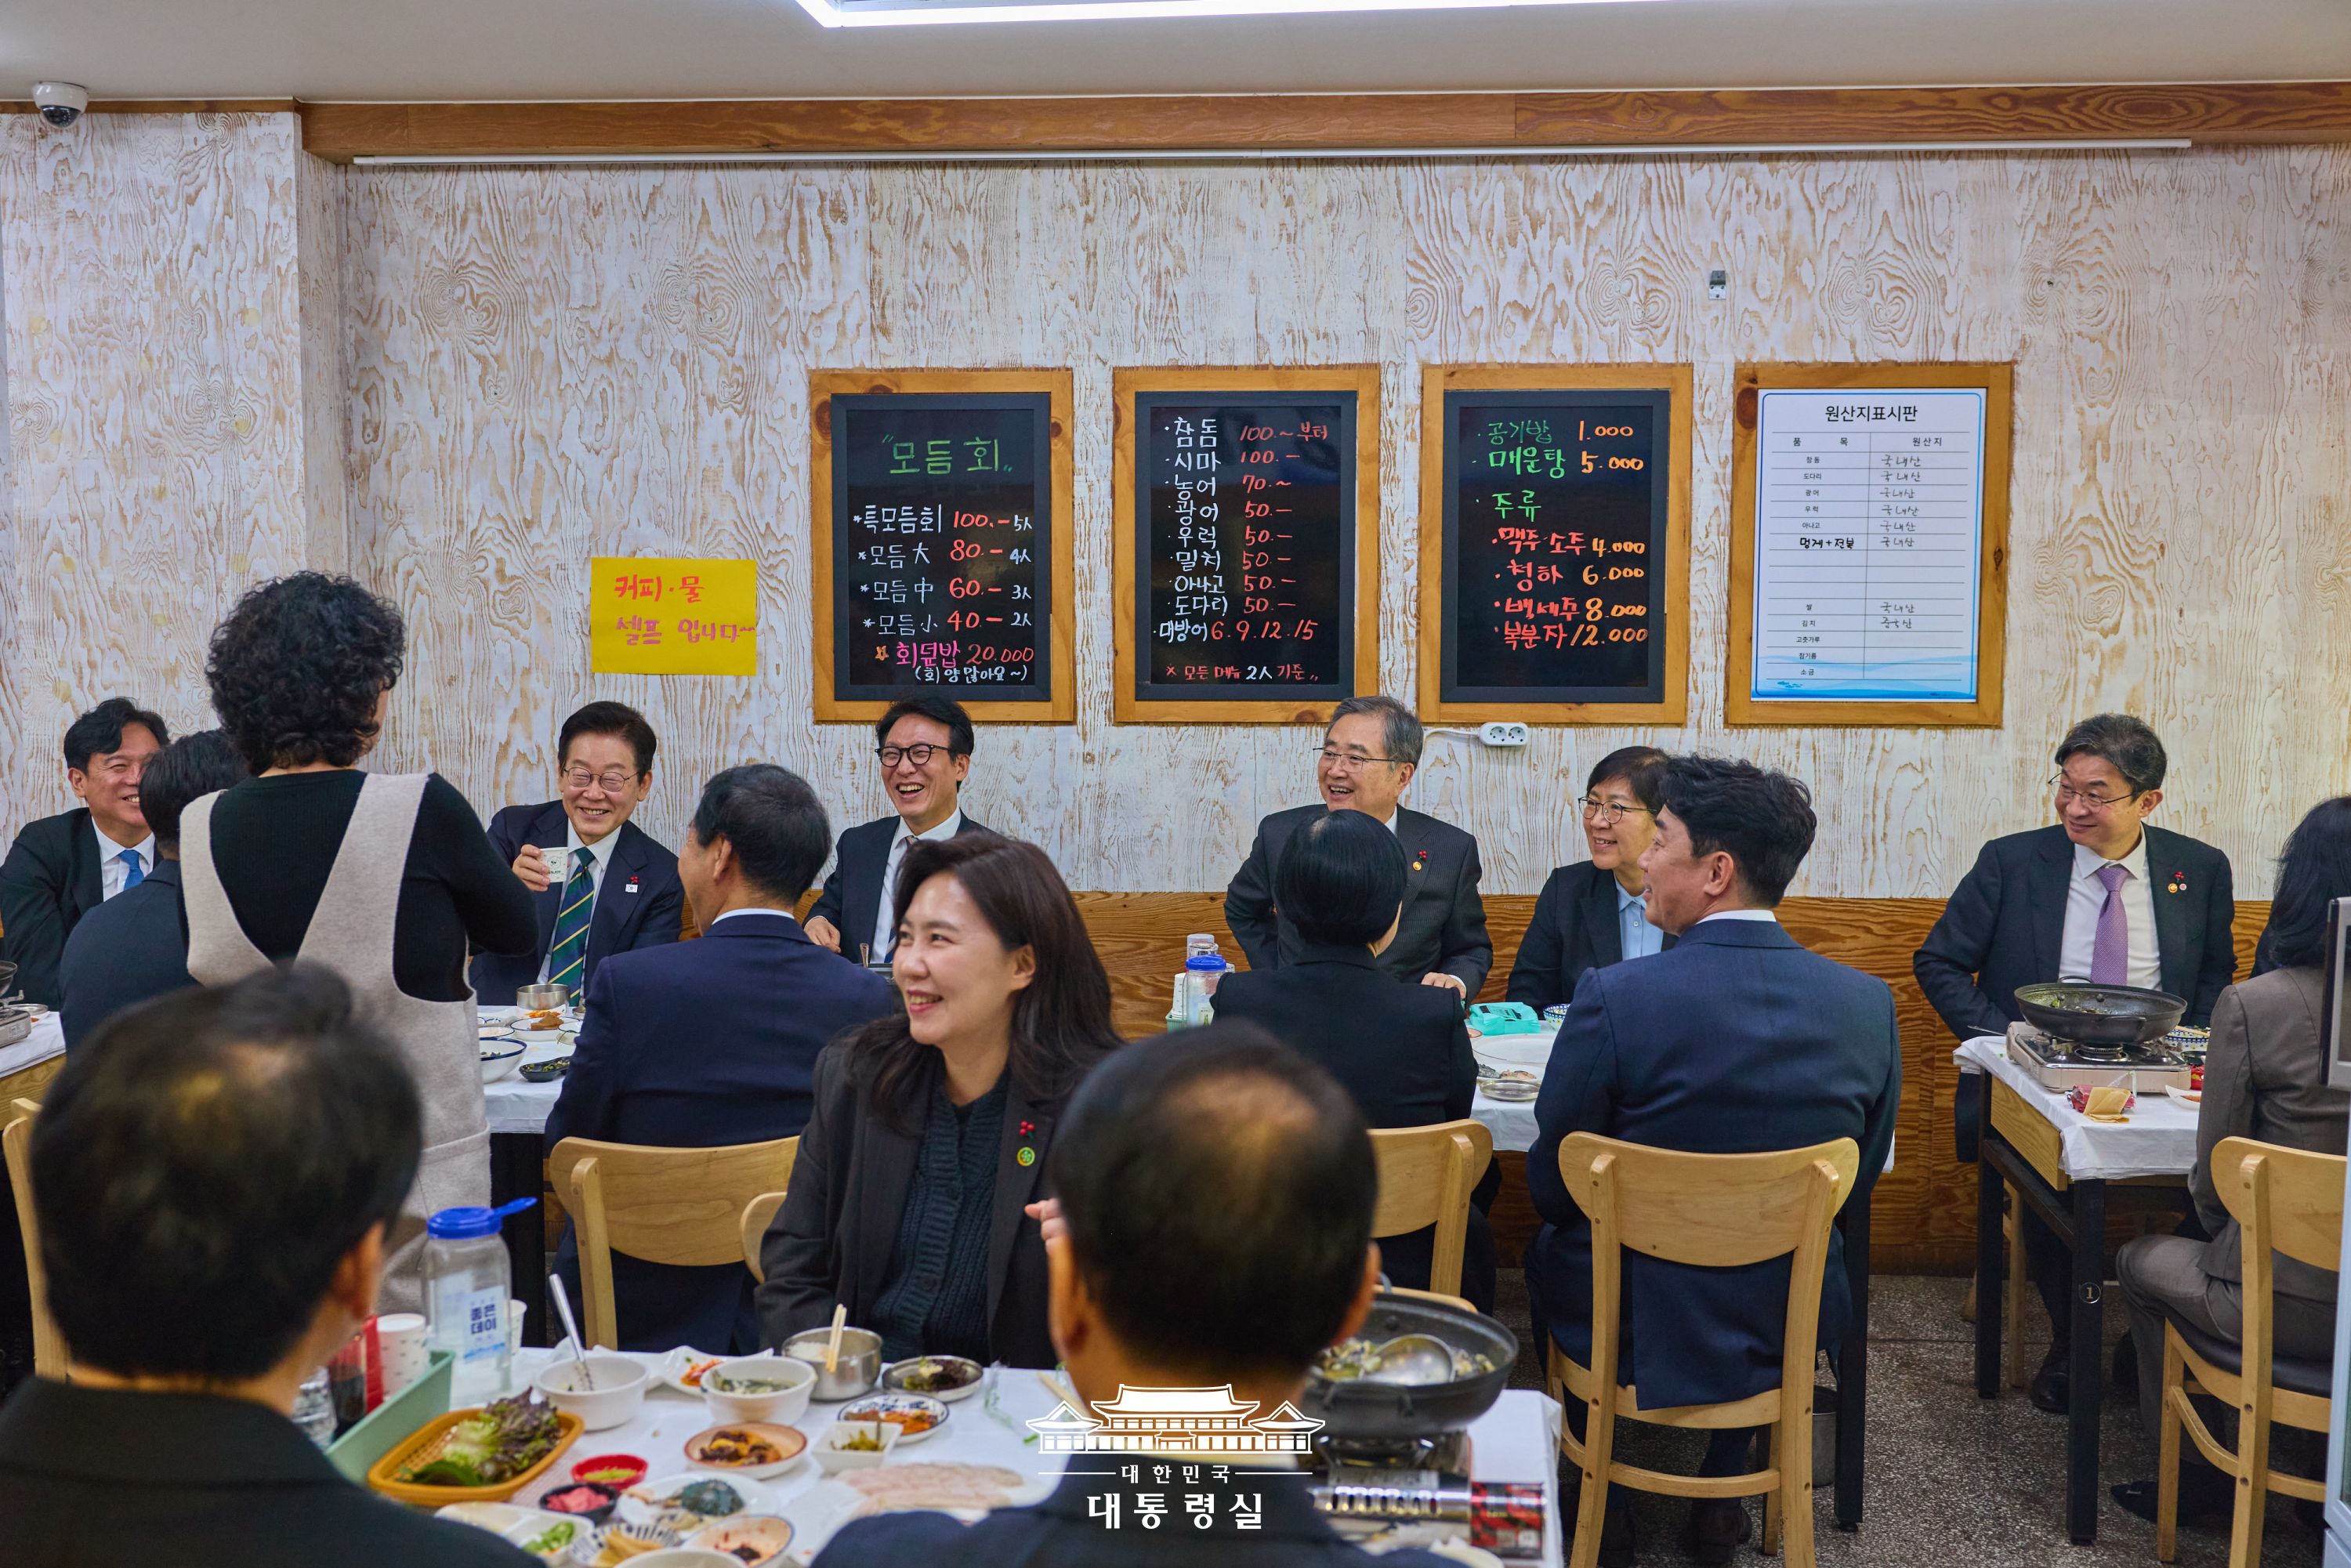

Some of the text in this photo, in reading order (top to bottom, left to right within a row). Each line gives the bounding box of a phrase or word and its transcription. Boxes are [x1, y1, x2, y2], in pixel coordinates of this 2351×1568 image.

[1825, 405, 1918, 422] 원산지표시판
[1298, 422, 1328, 441] 부터
[1489, 420, 1633, 444] 공기밥 1.000
[1912, 437, 1942, 447] 원산지
[1489, 447, 1643, 478] 매운탕 5.000
[1882, 454, 1921, 467] 국내산
[1881, 471, 1920, 482] 국내산
[1880, 487, 1914, 498] 국내산
[1492, 490, 1541, 522] 주류
[1881, 505, 1918, 516] 국내산
[1881, 520, 1915, 532] 국내산
[1592, 538, 1645, 557] 4.000
[1881, 537, 1914, 547] 국내산
[1176, 549, 1220, 571] 밀치
[1175, 575, 1225, 593] 아나고
[1507, 559, 1644, 592] 청하 6.000
[915, 577, 933, 603] 中
[1176, 596, 1227, 616] 도다리
[1505, 597, 1646, 621] 백세주 8.000
[1881, 602, 1914, 614] 국내산
[616, 614, 661, 646] 셀프
[1160, 618, 1208, 643] 대방어
[1881, 617, 1912, 628] 중국산
[1505, 621, 1647, 650] 복분자 12.000
[897, 640, 1034, 668] 회덮밥 20.000
[1799, 651, 1817, 661] 참기름
[1185, 665, 1208, 679] 모든
[1215, 666, 1241, 679] 메뉴
[2086, 1287, 2093, 1299] 1
[470, 1317, 496, 1334] 데이
